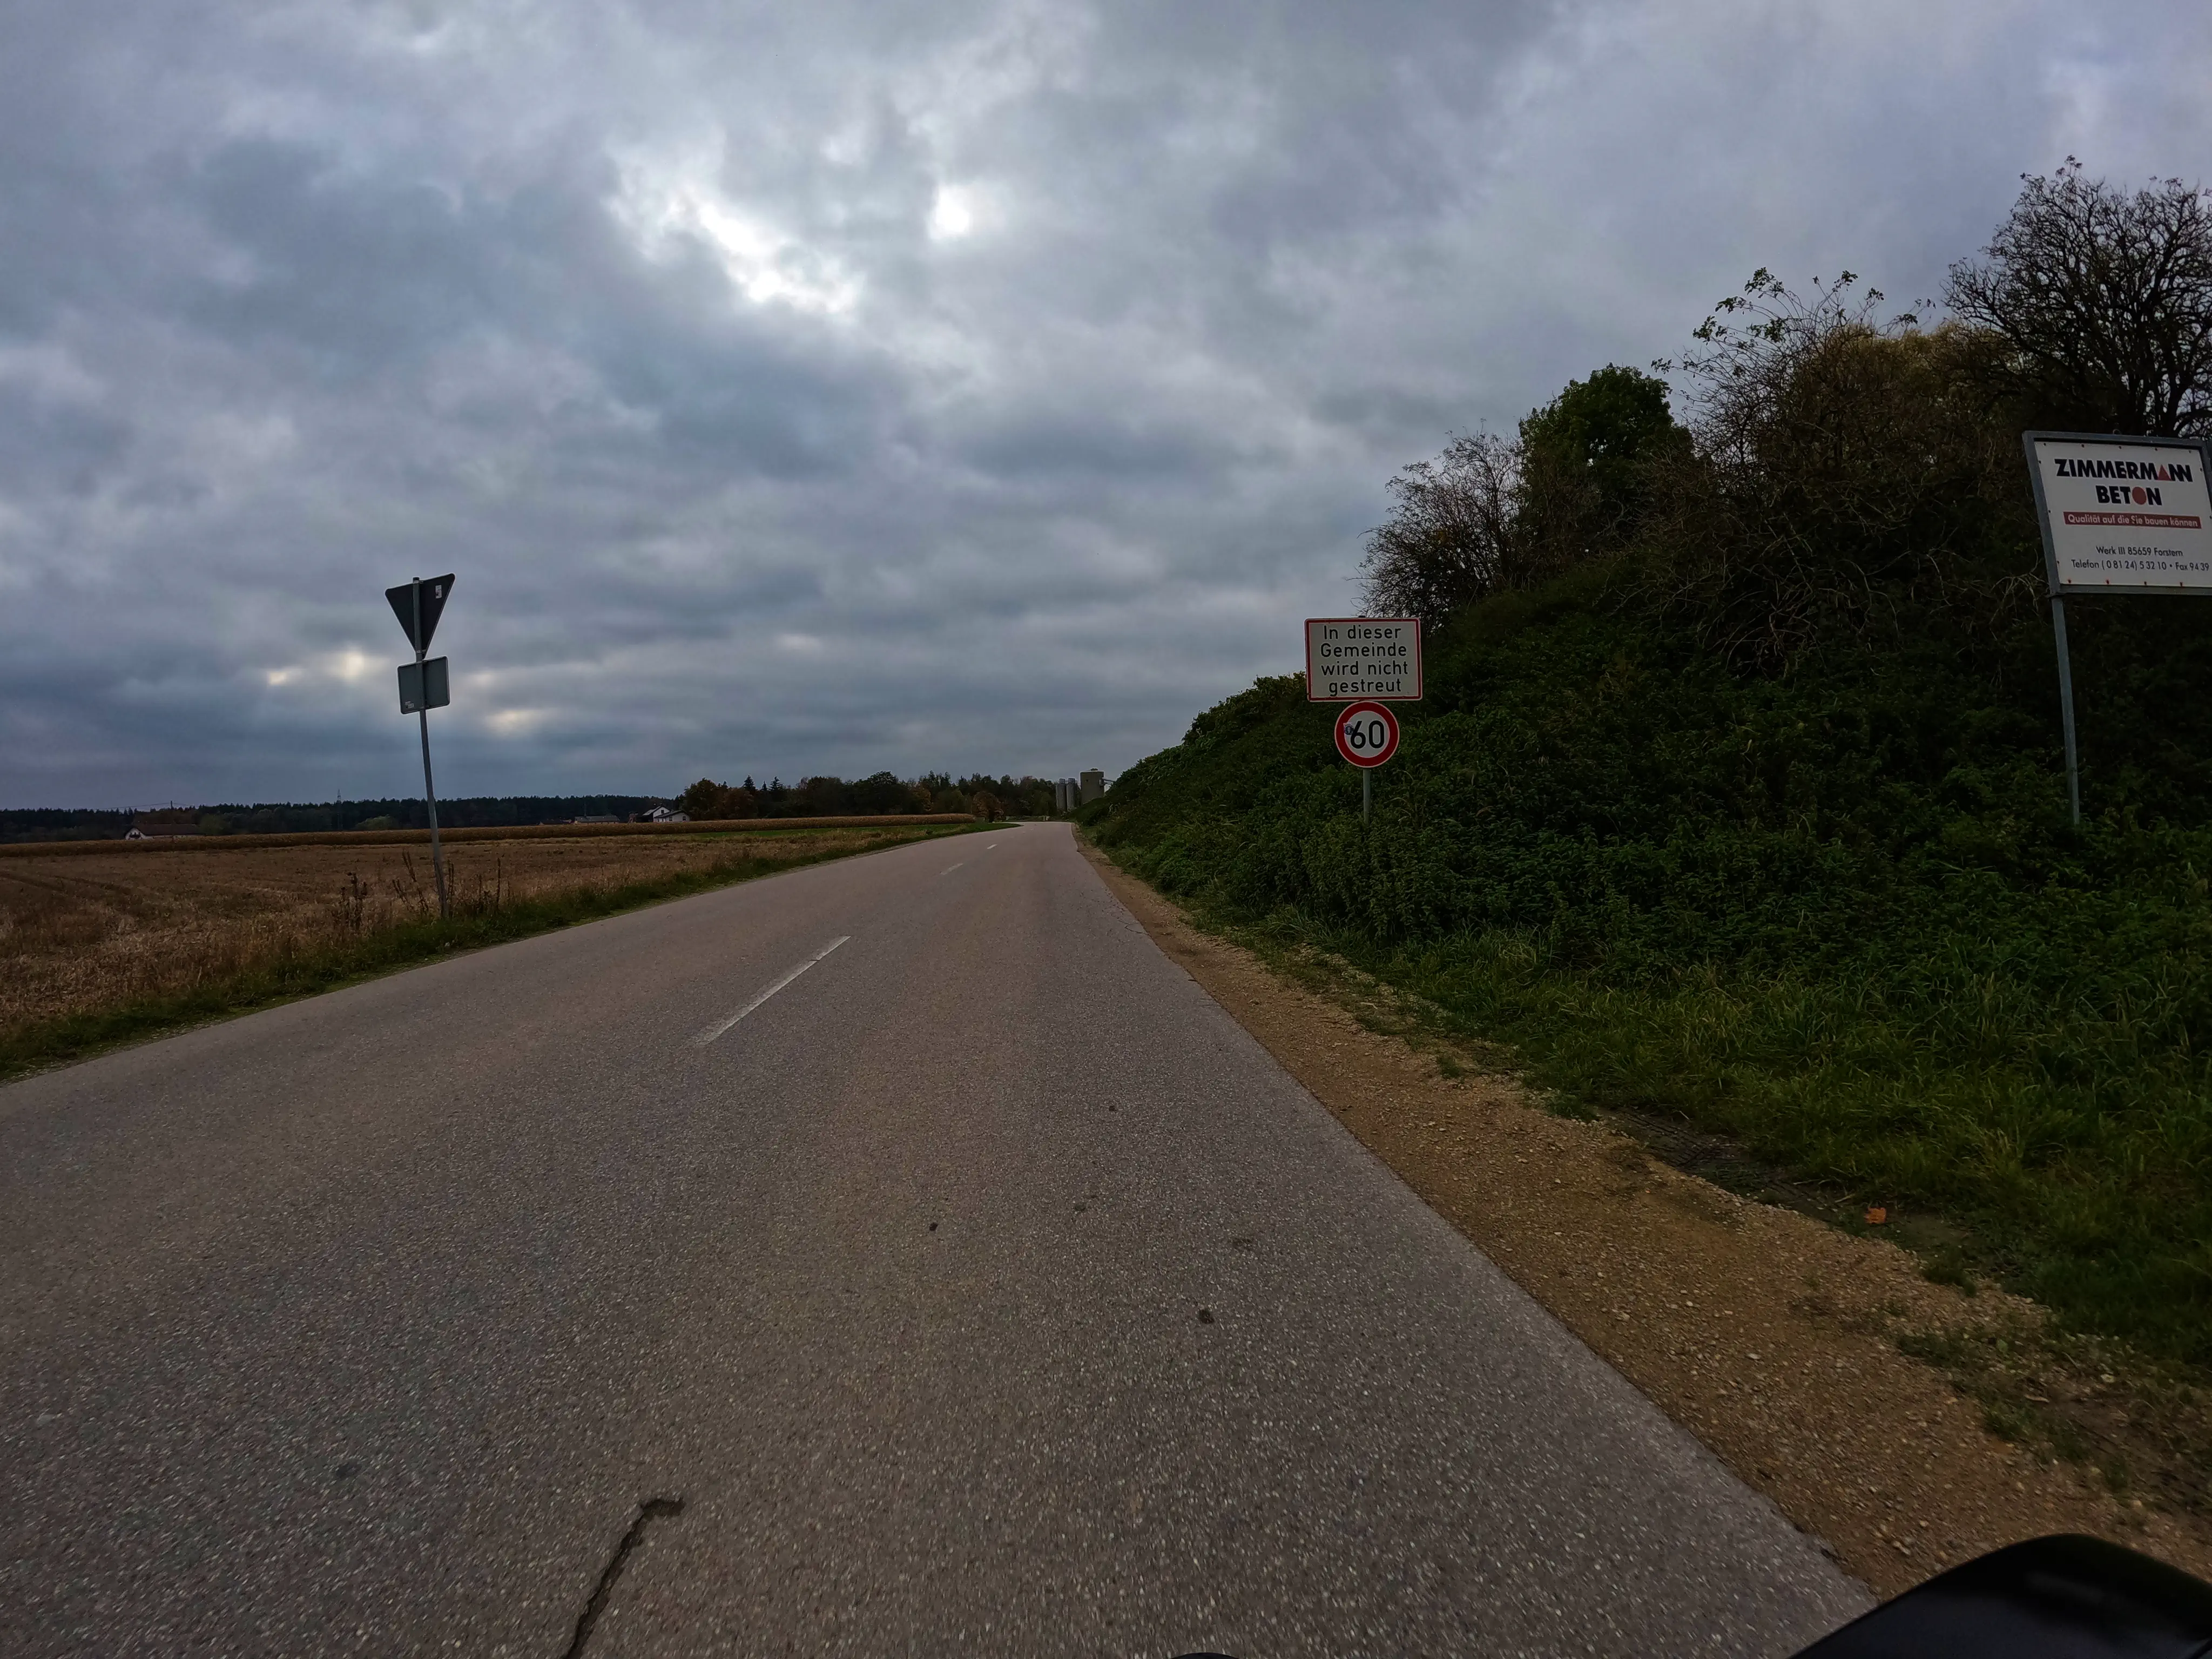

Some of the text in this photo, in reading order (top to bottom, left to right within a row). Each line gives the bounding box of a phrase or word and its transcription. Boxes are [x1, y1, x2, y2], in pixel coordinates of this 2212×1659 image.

[2054, 458, 2193, 482] ZIMMERMANN
[2095, 485, 2162, 505] BETON
[2068, 514, 2198, 527] Qualität auf die Sie bauen können
[2095, 545, 2117, 555] Werk
[2127, 546, 2152, 556] 85659
[2154, 547, 2183, 557] Forstern
[2071, 558, 2100, 569] Telefon
[2175, 562, 2188, 571] Fax
[1323, 624, 1401, 640] In dieser
[1320, 642, 1407, 657] Gemeinde
[1320, 660, 1409, 676] wird nicht
[1328, 678, 1401, 697] gestreut
[1350, 720, 1385, 749] 60
